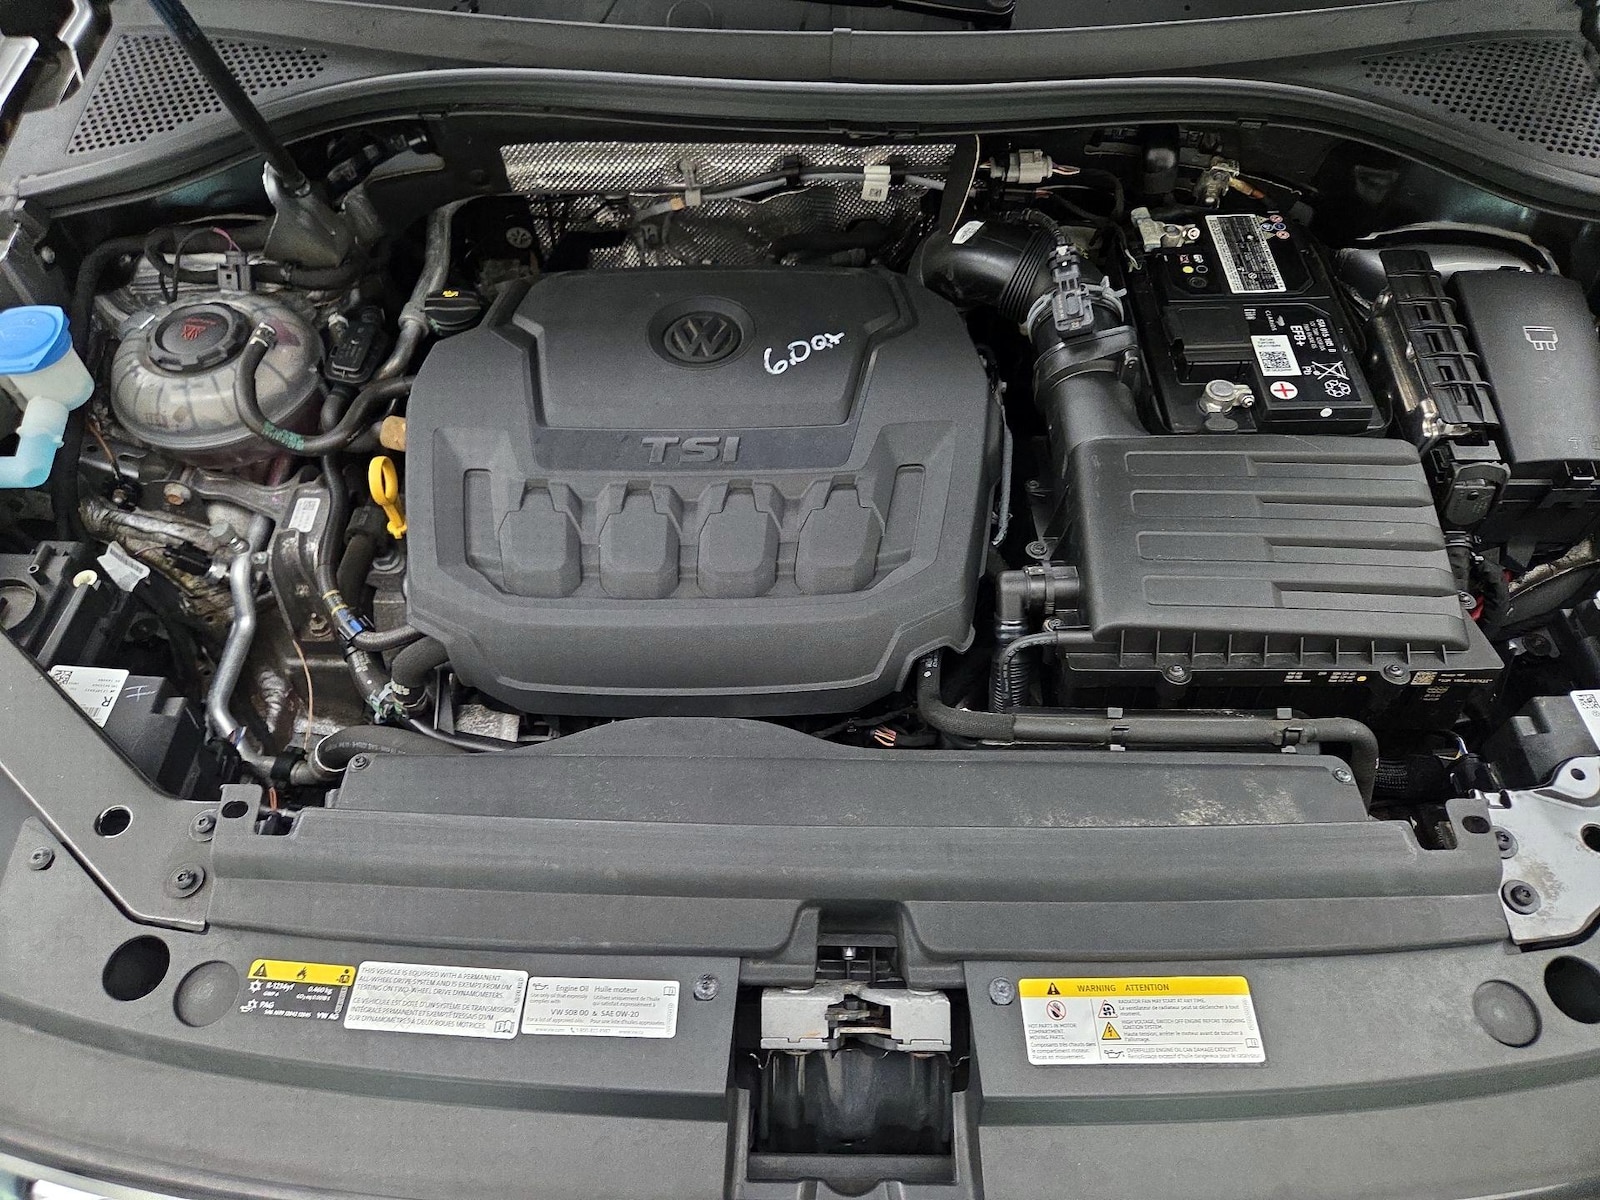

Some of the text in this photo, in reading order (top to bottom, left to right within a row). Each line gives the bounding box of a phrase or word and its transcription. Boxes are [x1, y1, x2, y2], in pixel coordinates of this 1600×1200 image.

[1265, 310, 1278, 331] CLARIOS
[1290, 325, 1307, 347] EFB+
[1301, 365, 1313, 376] Pb
[641, 436, 741, 464] TSI
[101, 696, 113, 707] R
[556, 985, 578, 993] Engine
[472, 1004, 516, 1012] TRANSMISSION
